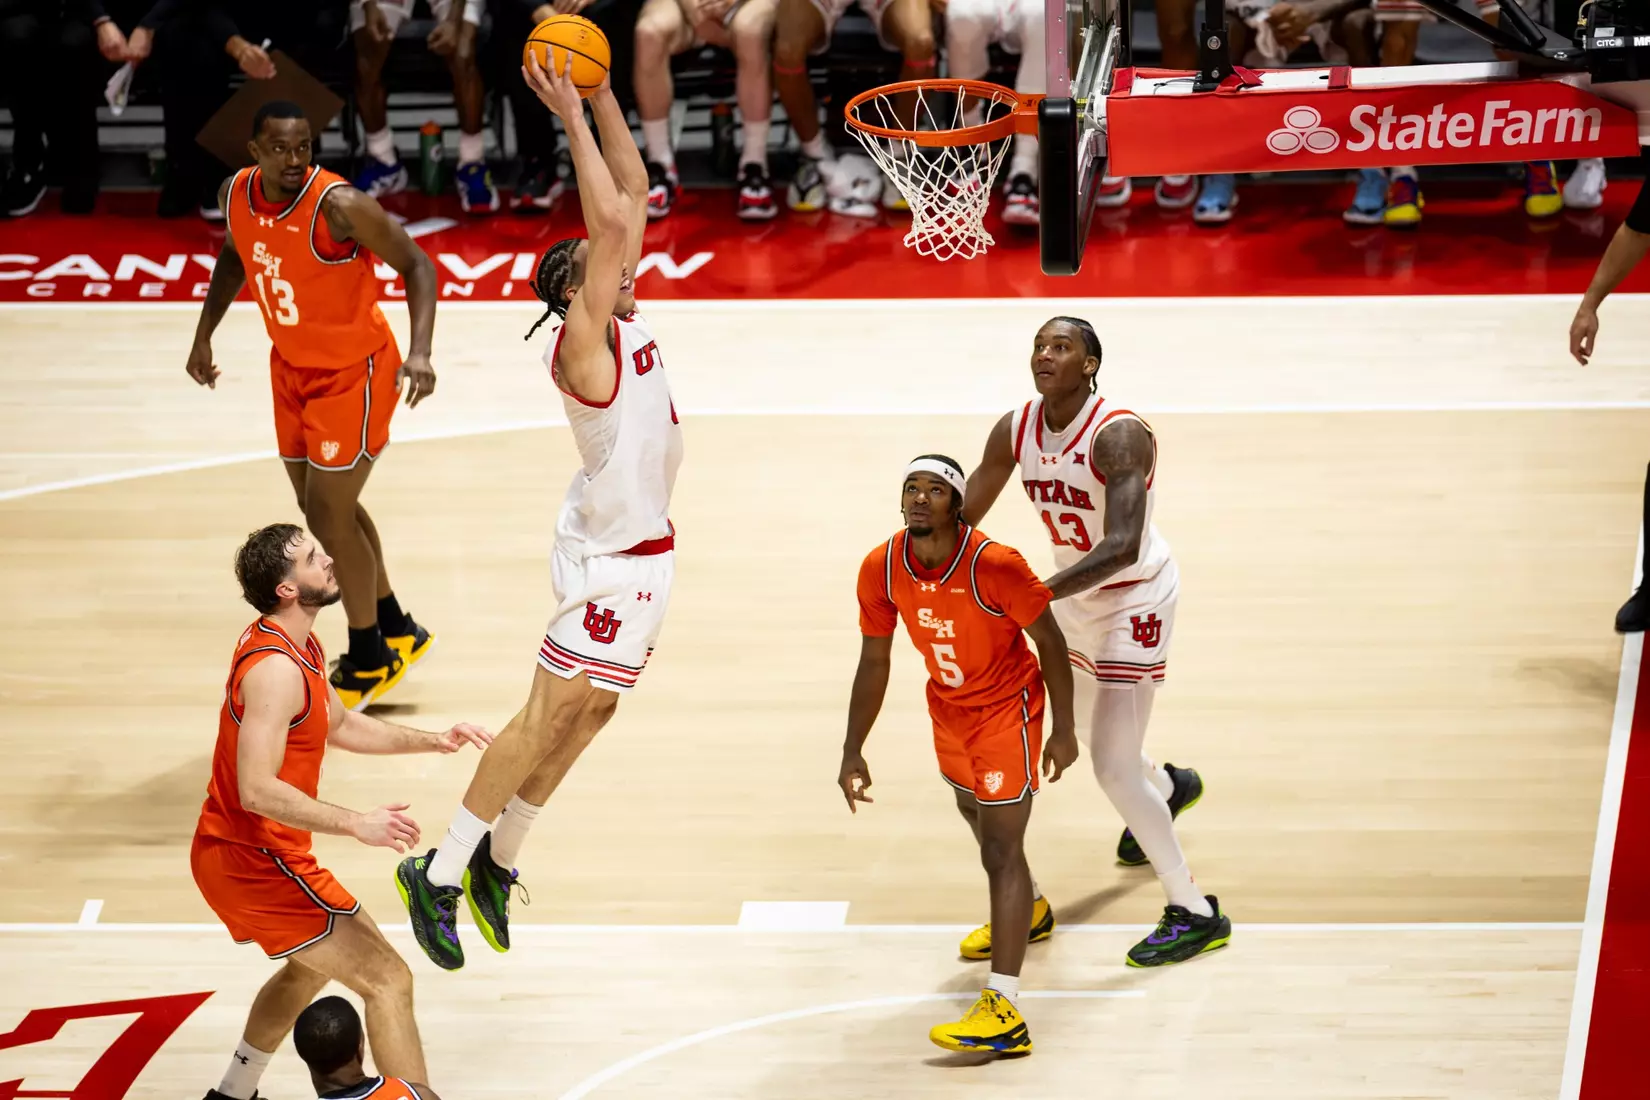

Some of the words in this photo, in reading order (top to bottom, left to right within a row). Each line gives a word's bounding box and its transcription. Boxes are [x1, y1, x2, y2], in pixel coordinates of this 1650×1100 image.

[437, 253, 715, 280] VIW
[255, 272, 299, 326] 13
[1041, 509, 1092, 552] 13
[930, 643, 965, 688] 5
